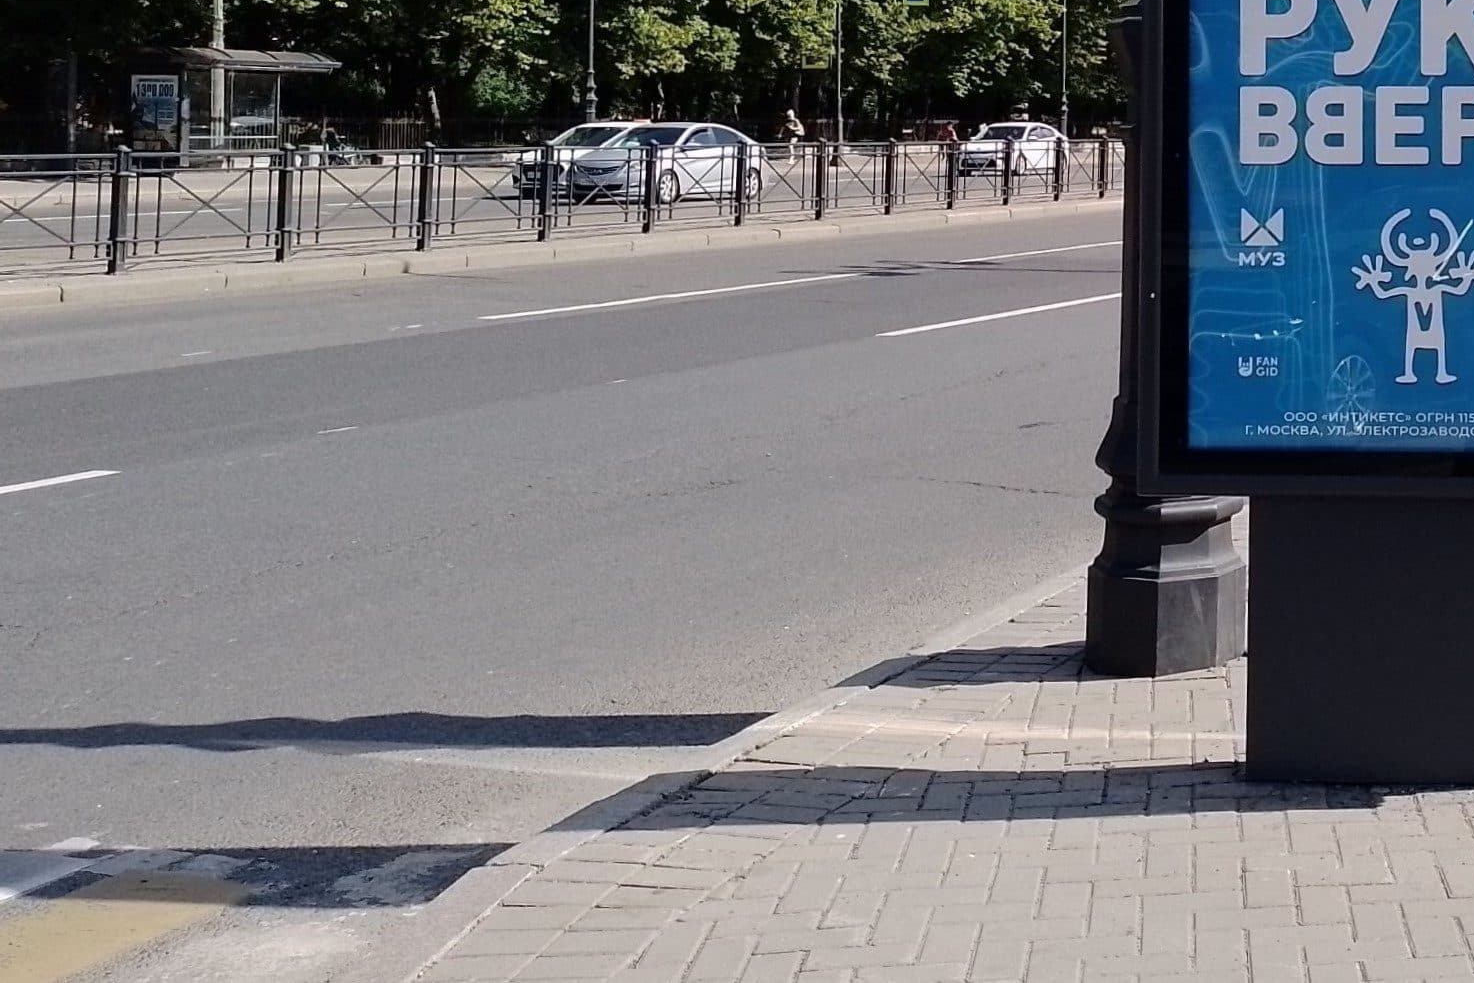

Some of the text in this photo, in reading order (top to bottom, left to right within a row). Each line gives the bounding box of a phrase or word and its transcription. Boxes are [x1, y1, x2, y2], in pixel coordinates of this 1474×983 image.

[1238, 252, 1286, 267] МУЗ
[1256, 357, 1278, 366] FAN
[1256, 367, 1278, 377] GID
[1283, 412, 1317, 422] ООО
[1322, 412, 1411, 423] «ИНТИКЕТС»
[1415, 413, 1454, 423] ОГРН
[1258, 425, 1323, 437] МОСКВА,
